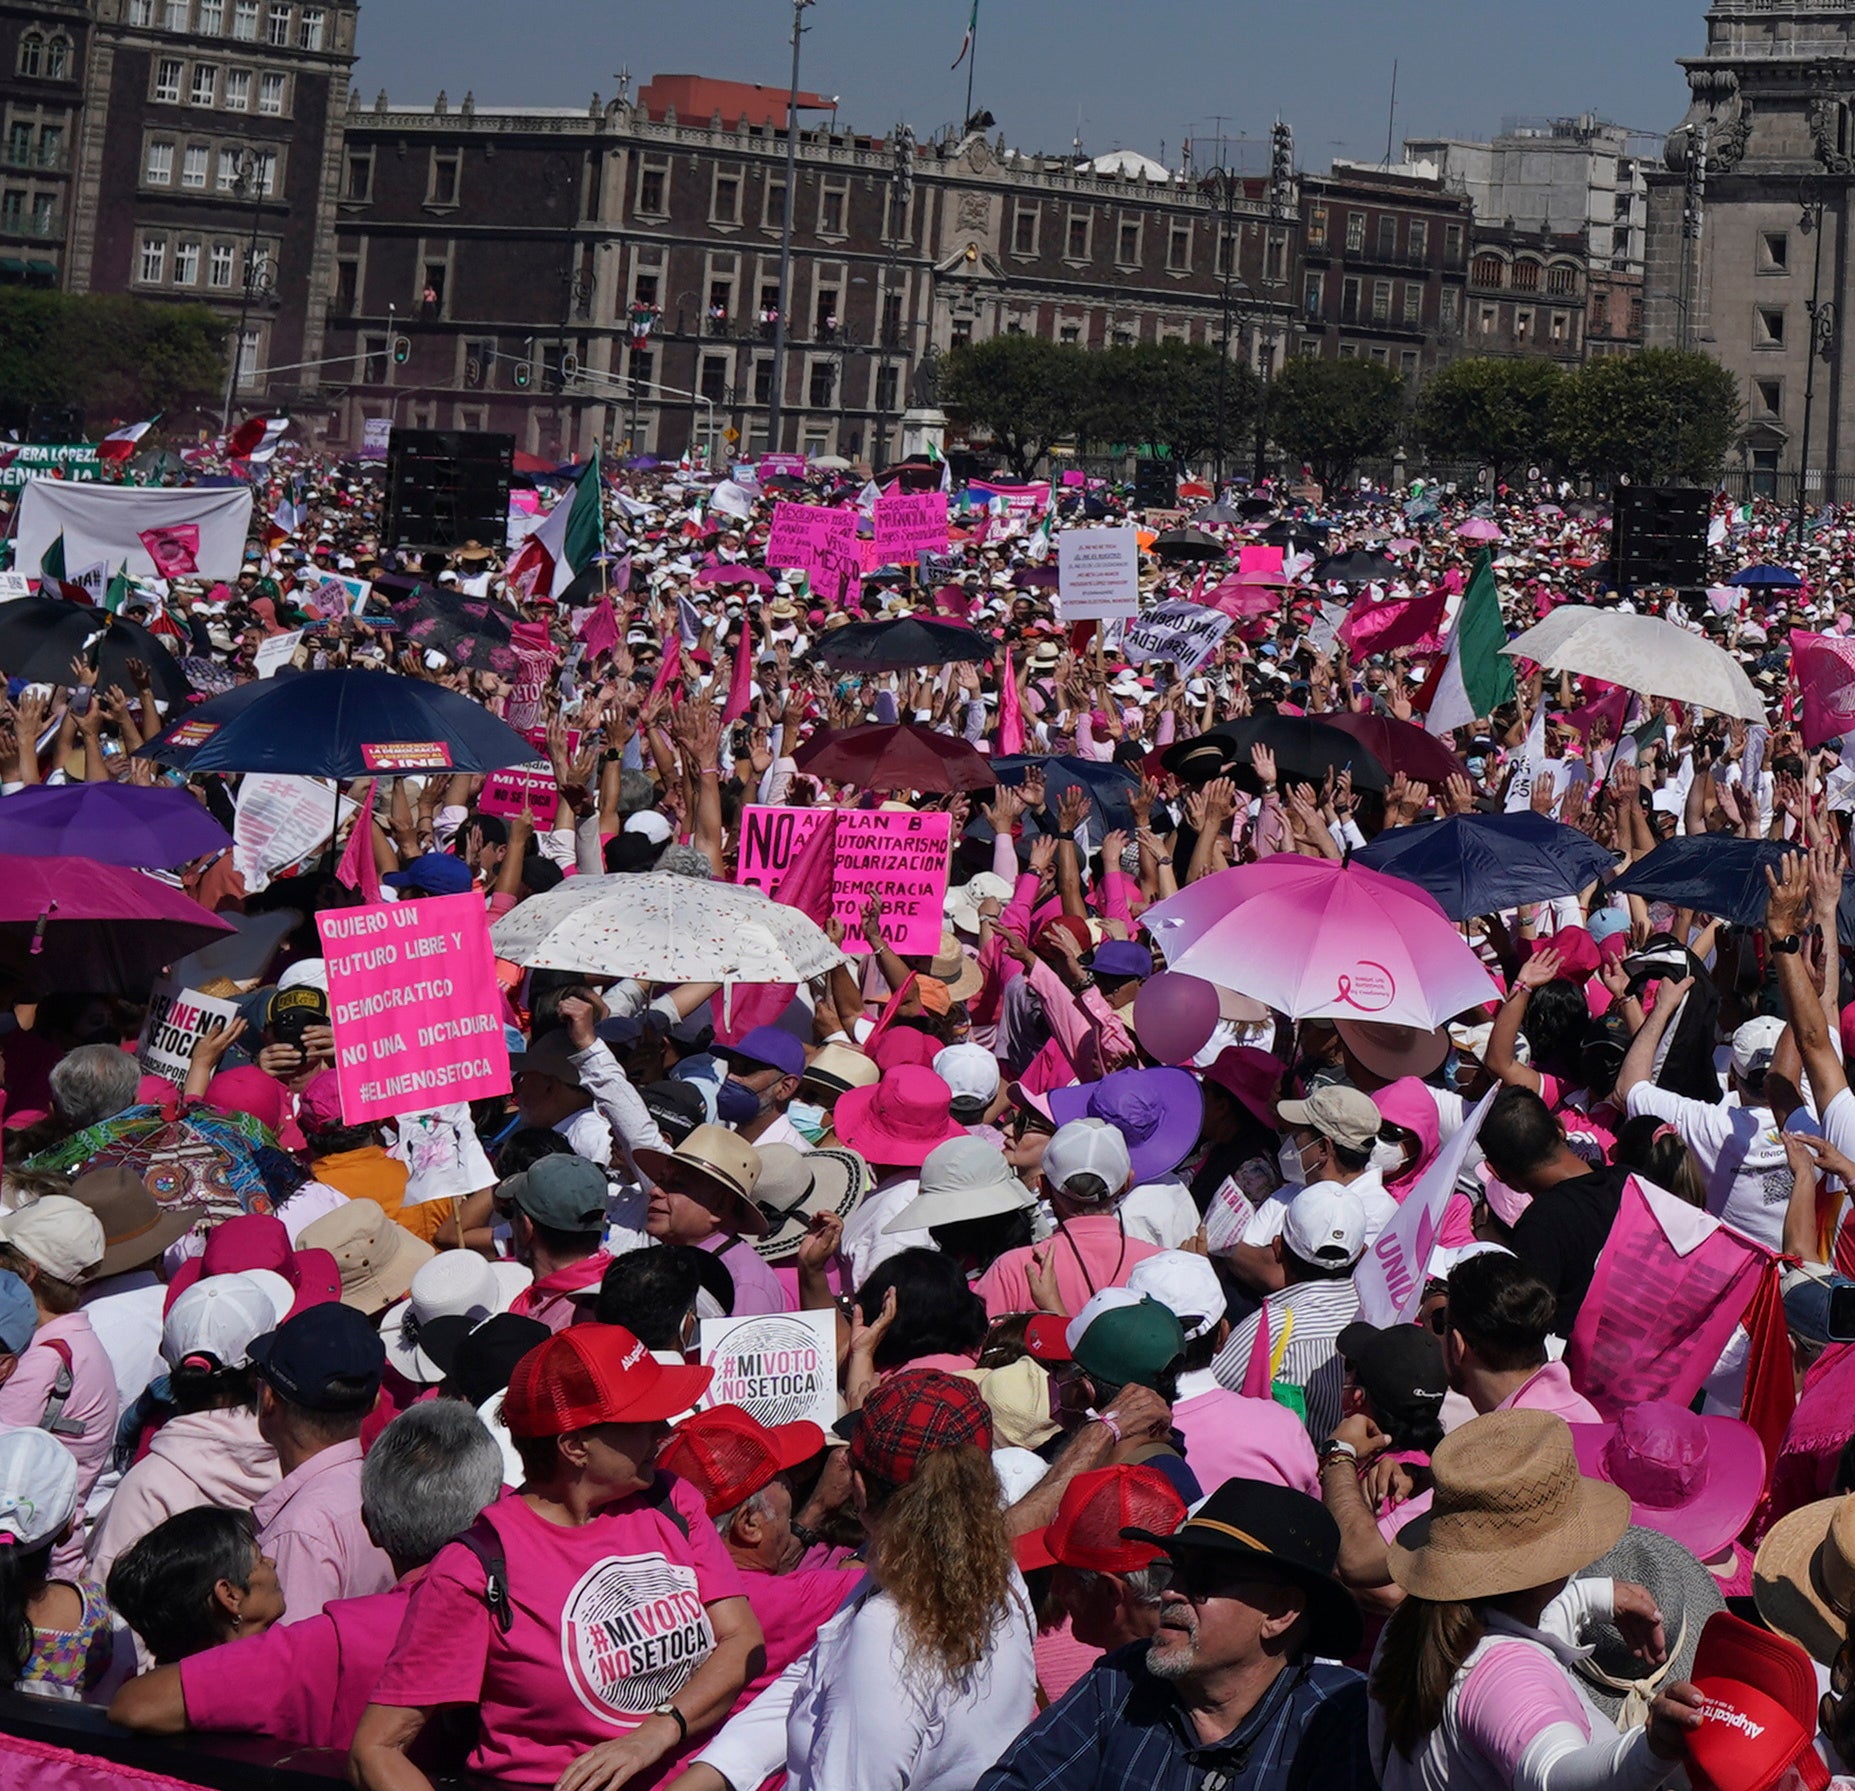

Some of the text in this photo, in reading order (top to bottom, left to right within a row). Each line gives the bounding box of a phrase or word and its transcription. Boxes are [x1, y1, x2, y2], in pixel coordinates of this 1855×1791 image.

[398, 758, 447, 768] INE
[492, 773, 514, 785] MI
[745, 813, 795, 870] NO
[835, 814, 890, 830] PLAN
[836, 834, 948, 854] UTORITARISMO
[833, 880, 935, 897] DEMOCRACIA
[322, 907, 419, 939] QUIERO UN
[329, 932, 462, 979] FUTURO LIBRE Y
[336, 978, 454, 1025] DEMOCRATICO
[151, 1019, 196, 1059] SETOC
[341, 1013, 498, 1068] NO UNA DICTADURA
[359, 1058, 493, 1103] #ELINENOSETOCA
[722, 1348, 817, 1380] #MIVOTO
[721, 1373, 817, 1403] NOSETOCA
[588, 1589, 703, 1656] #MIVOTO
[597, 1622, 710, 1688] NOSETOCA
